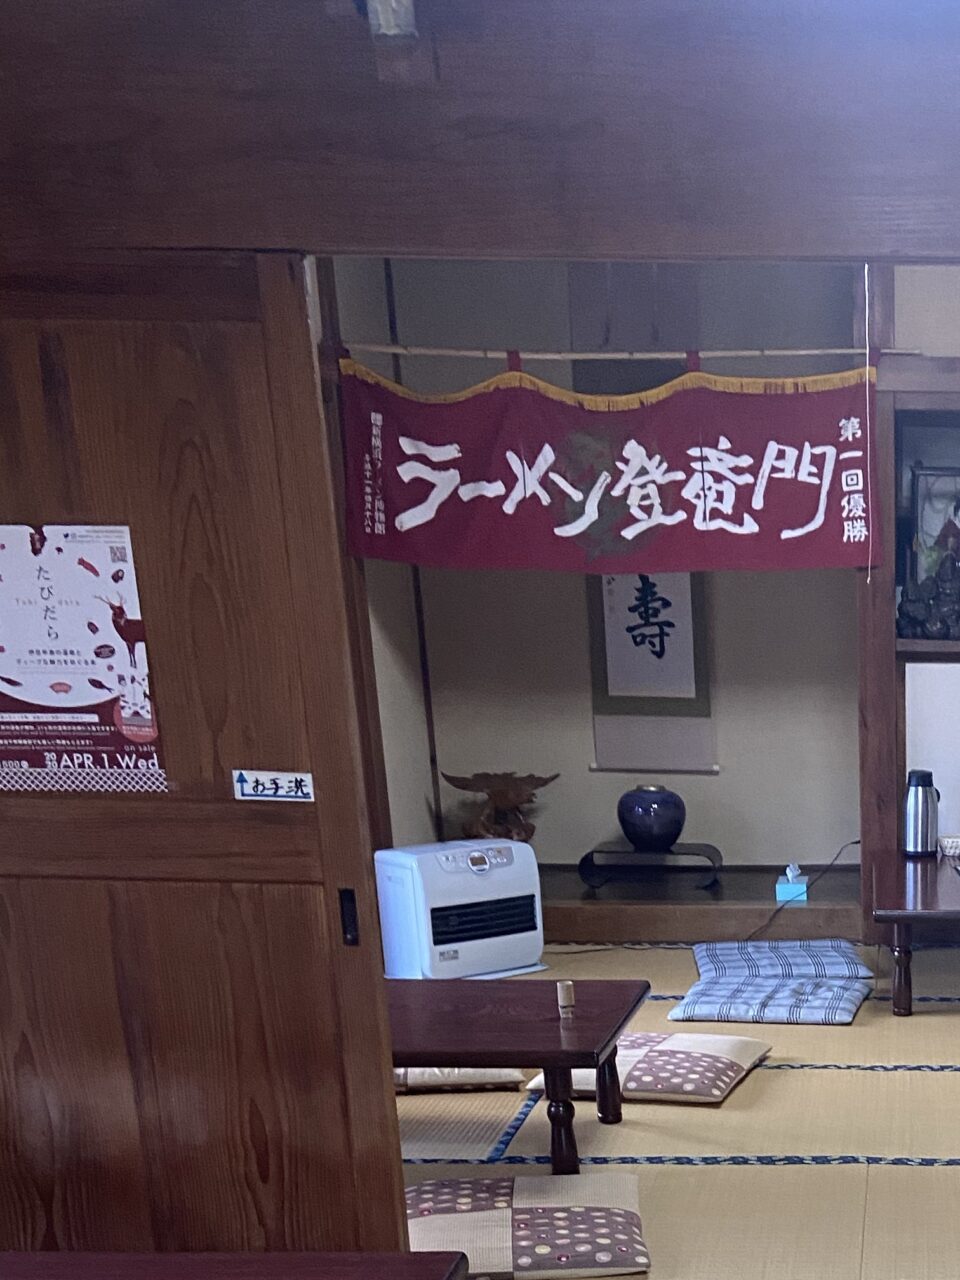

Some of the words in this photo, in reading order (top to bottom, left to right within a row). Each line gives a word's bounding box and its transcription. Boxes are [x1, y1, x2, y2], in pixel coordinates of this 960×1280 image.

[395, 436, 838, 540] ラーメン登竜門
[839, 417, 868, 543] 第一回優勝
[36, 565, 58, 639] たびだら
[138, 744, 156, 752] sale
[252, 776, 310, 796] お手洗
